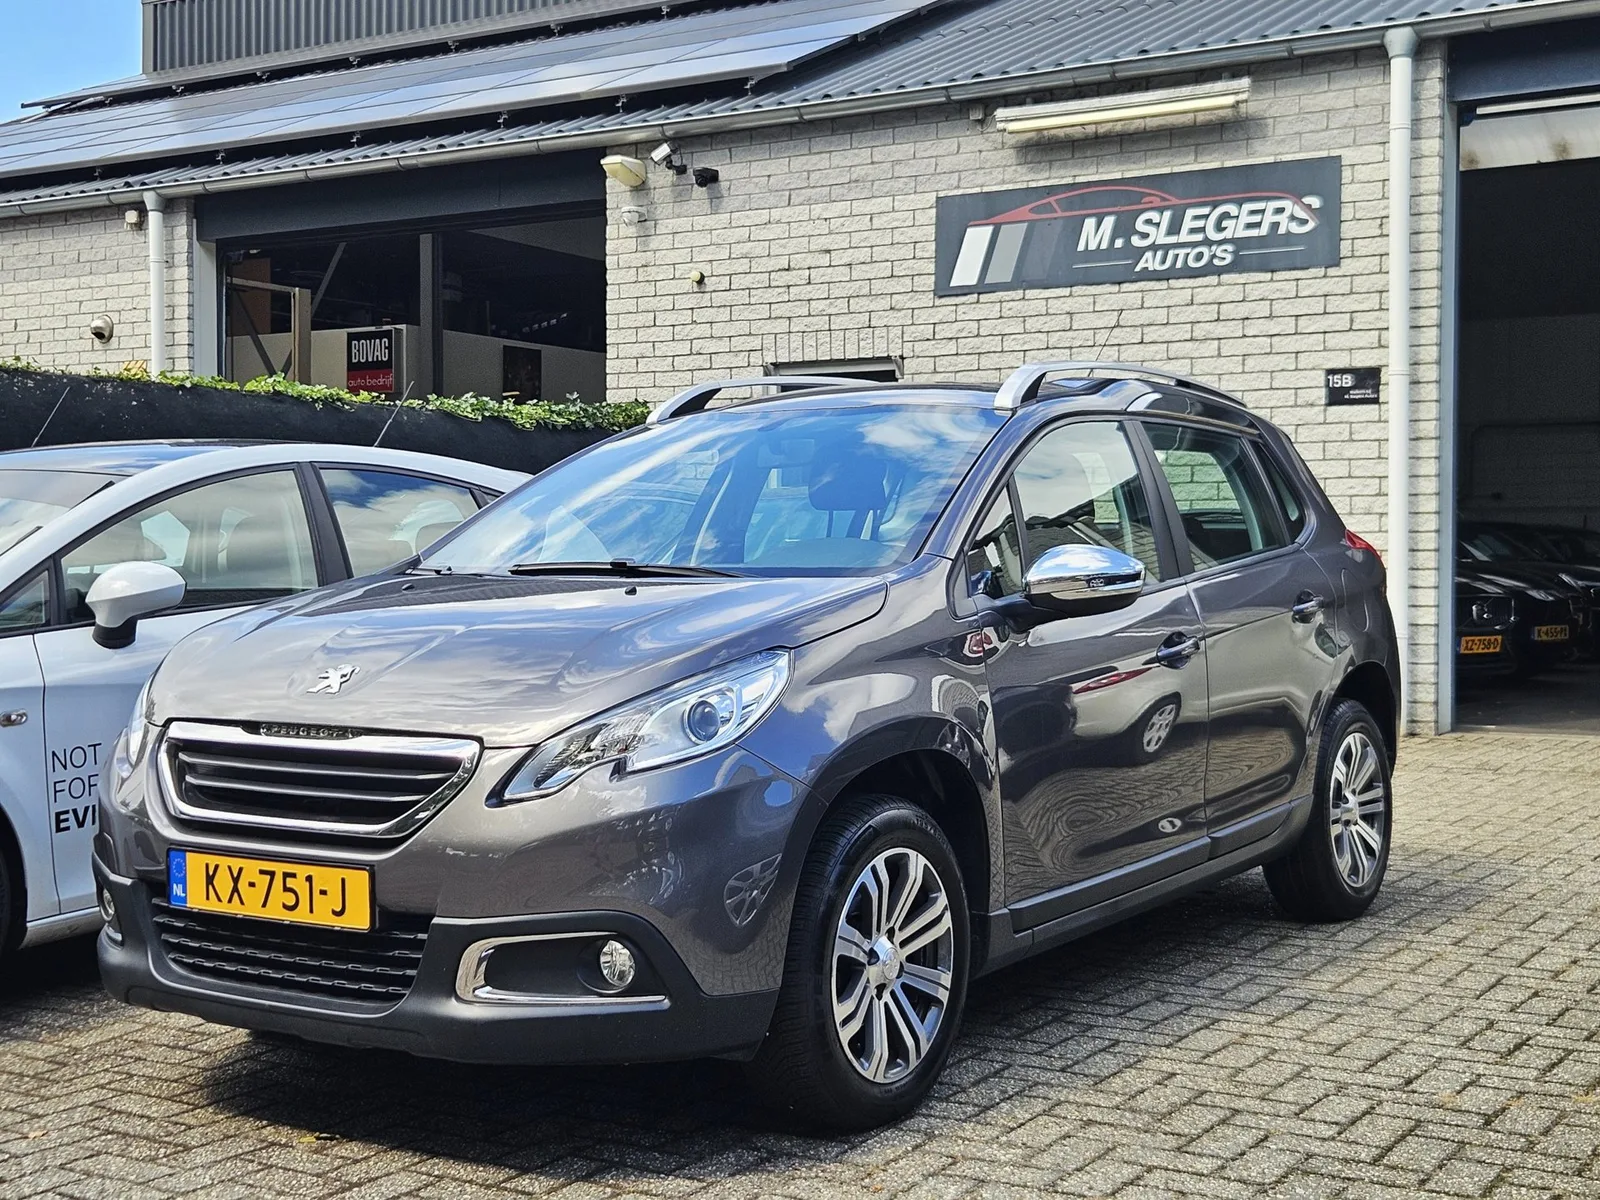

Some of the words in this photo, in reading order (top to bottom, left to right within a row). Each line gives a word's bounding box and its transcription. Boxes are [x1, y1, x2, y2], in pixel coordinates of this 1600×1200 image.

[1077, 214, 1126, 252] M.
[1130, 195, 1323, 248] SLEGERS
[1134, 243, 1236, 272] AUTO'S
[351, 338, 389, 363] BOVAG
[348, 377, 365, 387] auto
[366, 373, 393, 388] bedrijf
[1327, 373, 1355, 388] 15B
[1464, 637, 1499, 651] XZ-758-D
[270, 724, 343, 738] PEUGEOT
[51, 742, 102, 773] NOT
[173, 883, 186, 897] NL
[204, 862, 347, 917] KX-751-J
